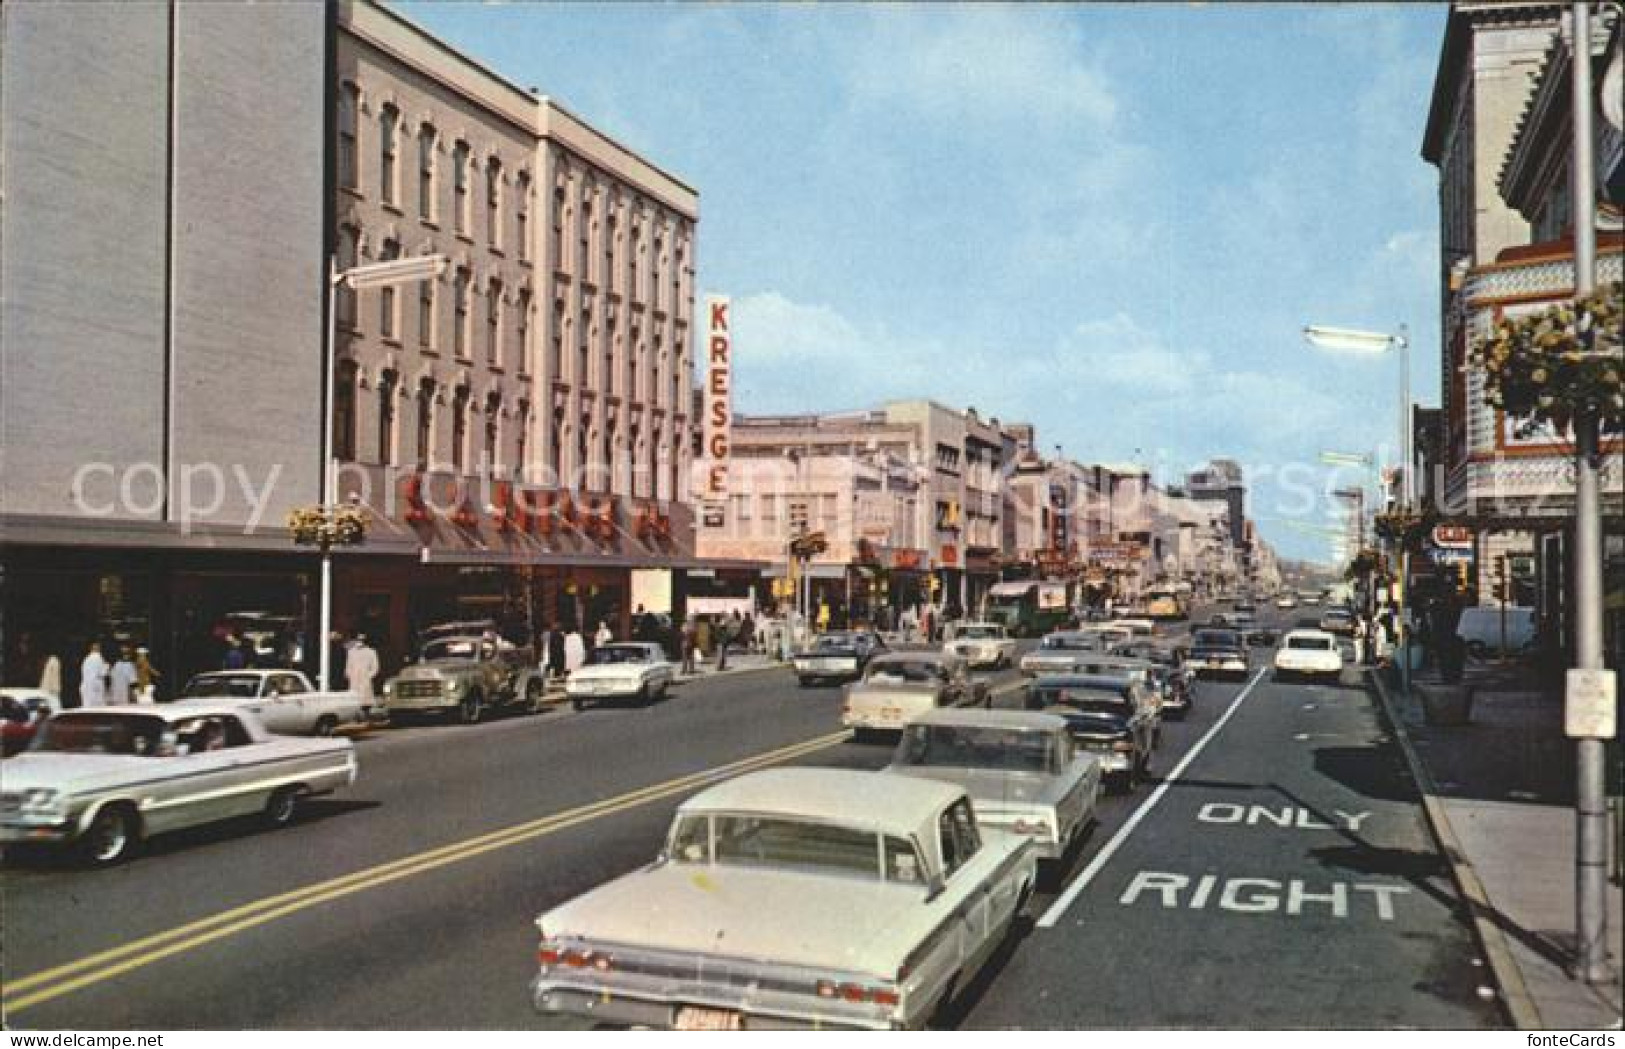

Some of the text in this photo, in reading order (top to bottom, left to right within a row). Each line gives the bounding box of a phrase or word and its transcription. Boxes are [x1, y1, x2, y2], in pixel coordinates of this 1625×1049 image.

[710, 302, 729, 492] KRESGE
[1197, 802, 1372, 832] ONLY
[1119, 871, 1411, 921] RIGHT
